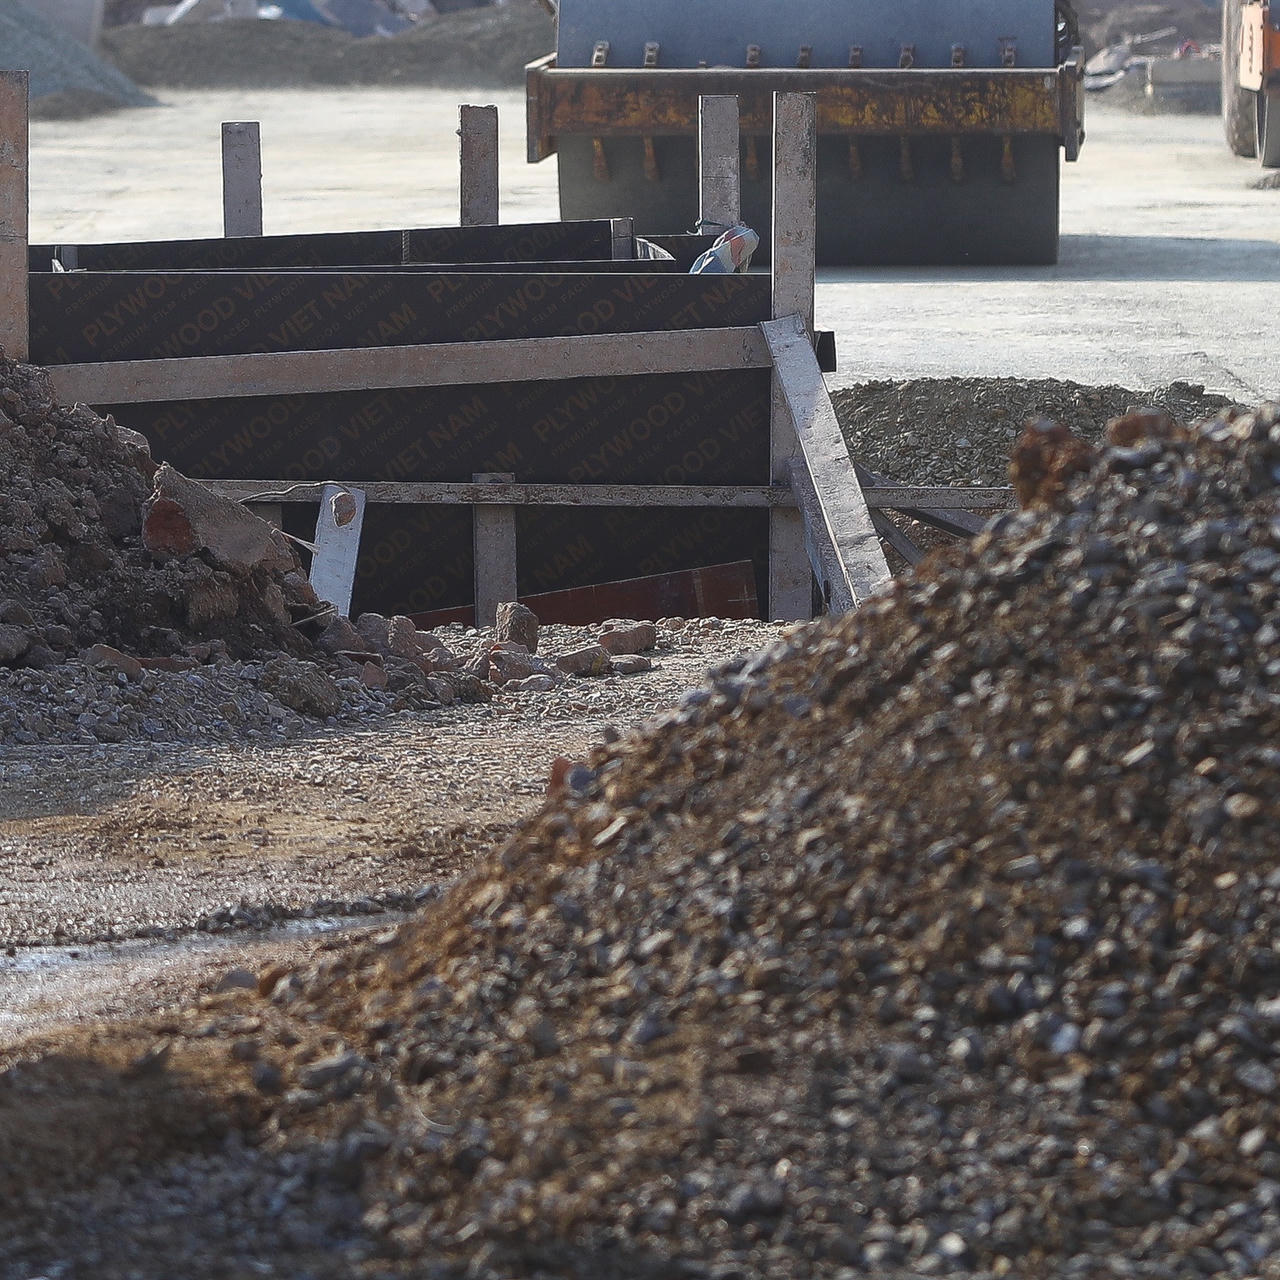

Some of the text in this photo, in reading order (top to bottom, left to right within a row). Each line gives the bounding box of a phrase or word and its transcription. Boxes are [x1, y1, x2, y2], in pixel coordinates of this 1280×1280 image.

[79, 274, 187, 349] PLYWOO
[268, 299, 329, 352] VIET
[337, 390, 402, 445] VIET
[426, 394, 491, 450] NAM
[531, 377, 622, 444] PLYWO
